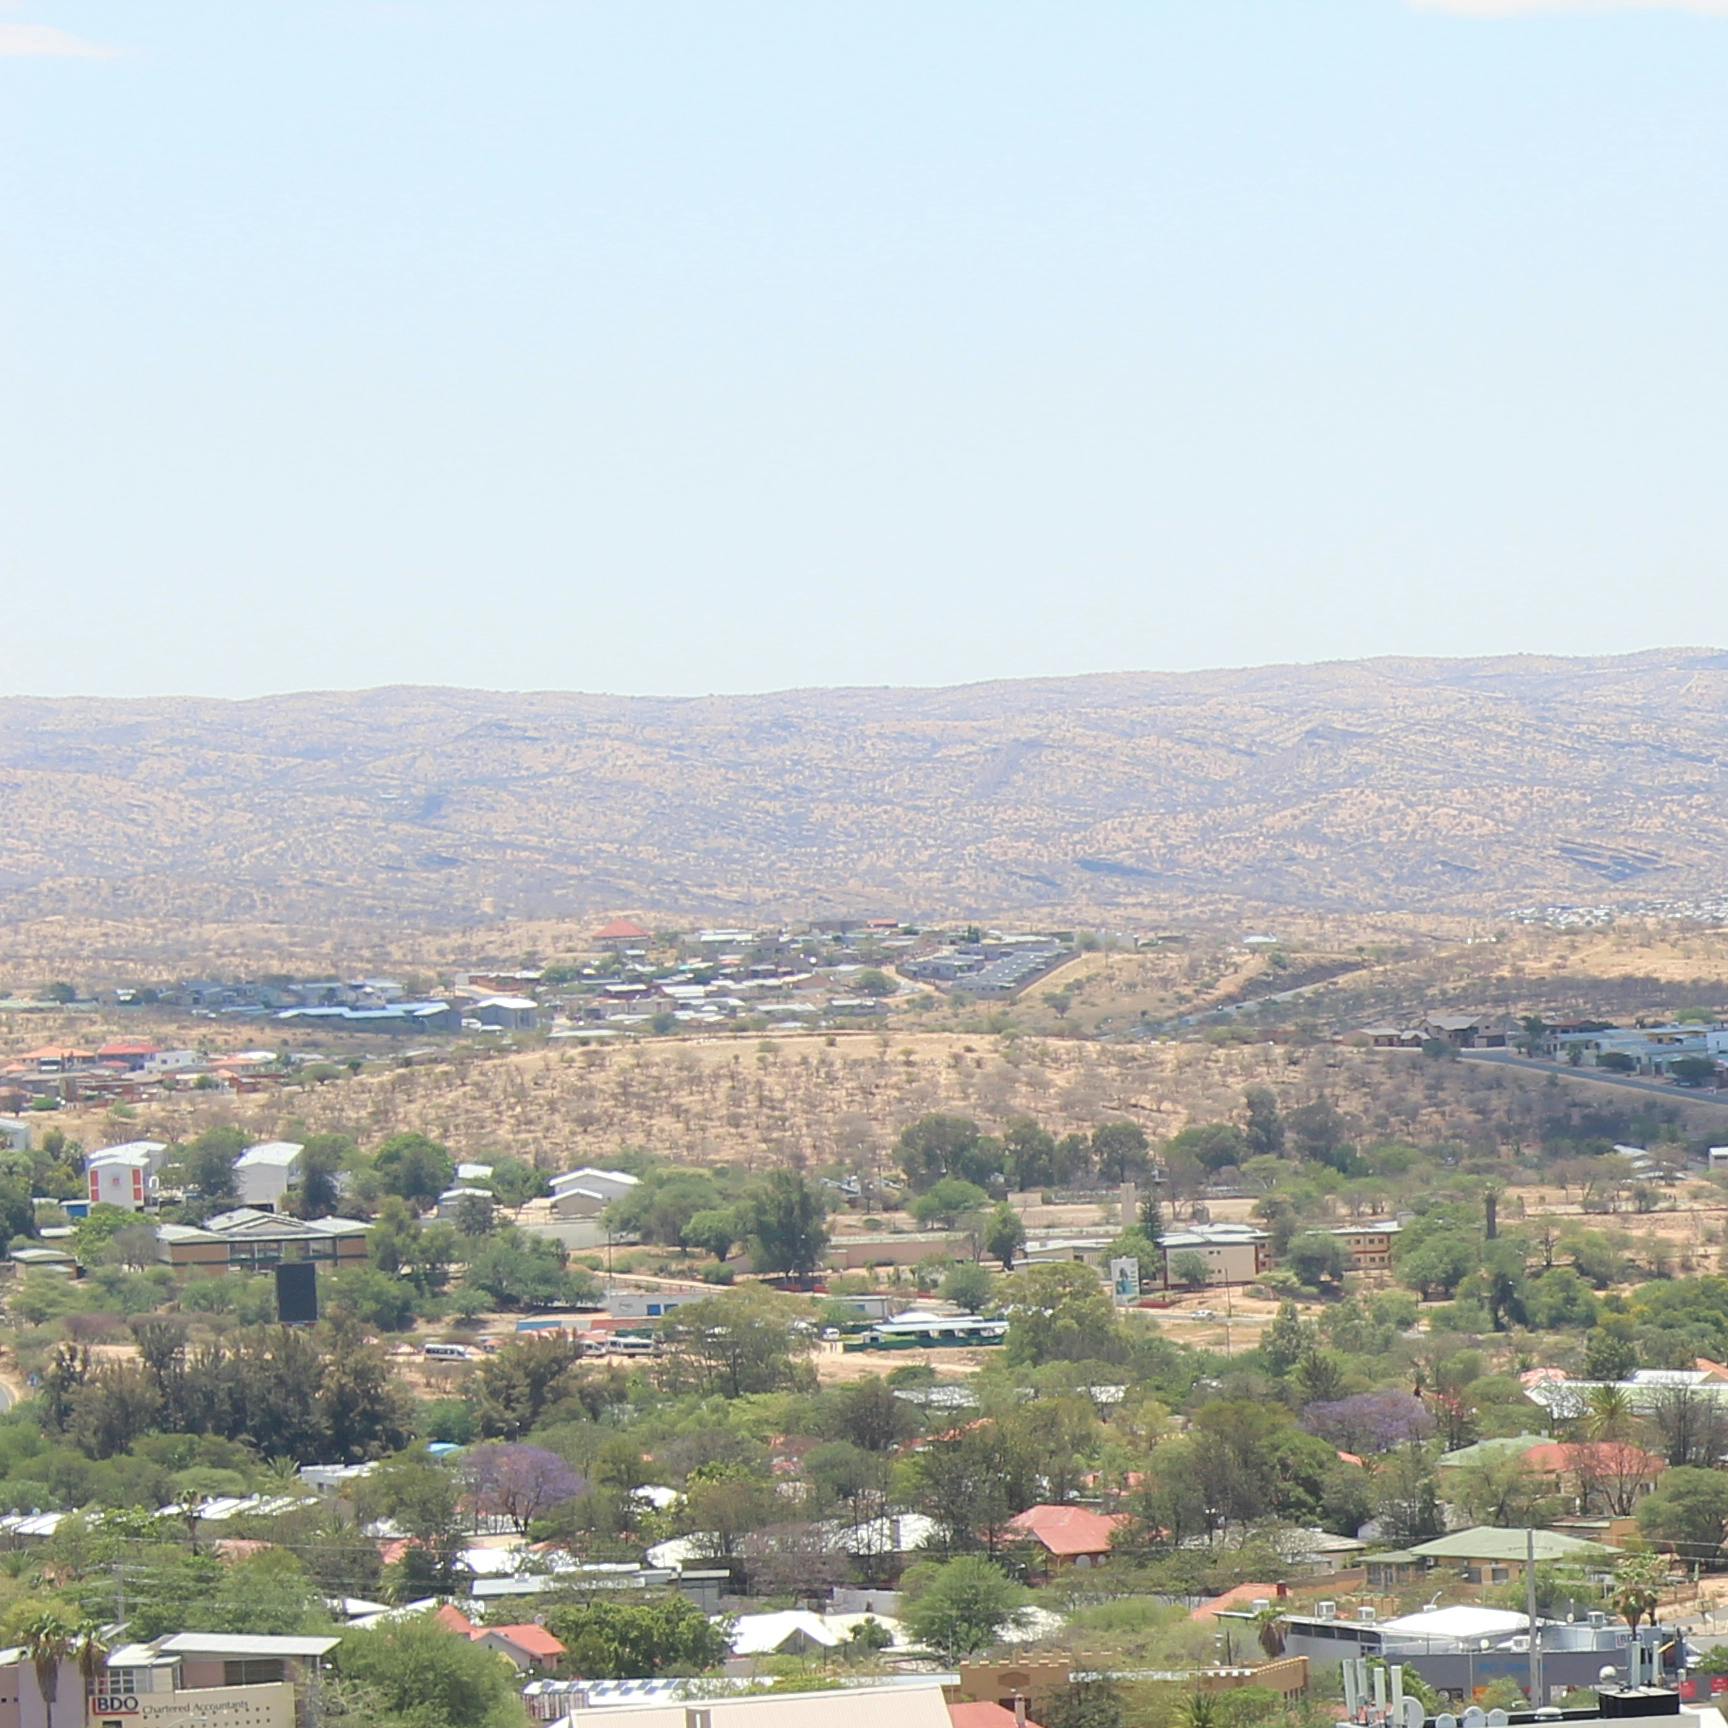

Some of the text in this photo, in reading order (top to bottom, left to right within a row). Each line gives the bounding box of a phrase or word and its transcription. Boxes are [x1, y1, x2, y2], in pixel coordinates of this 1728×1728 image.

[97, 1696, 138, 1711] BDO
[142, 1700, 249, 1714] Chartered Accountants
